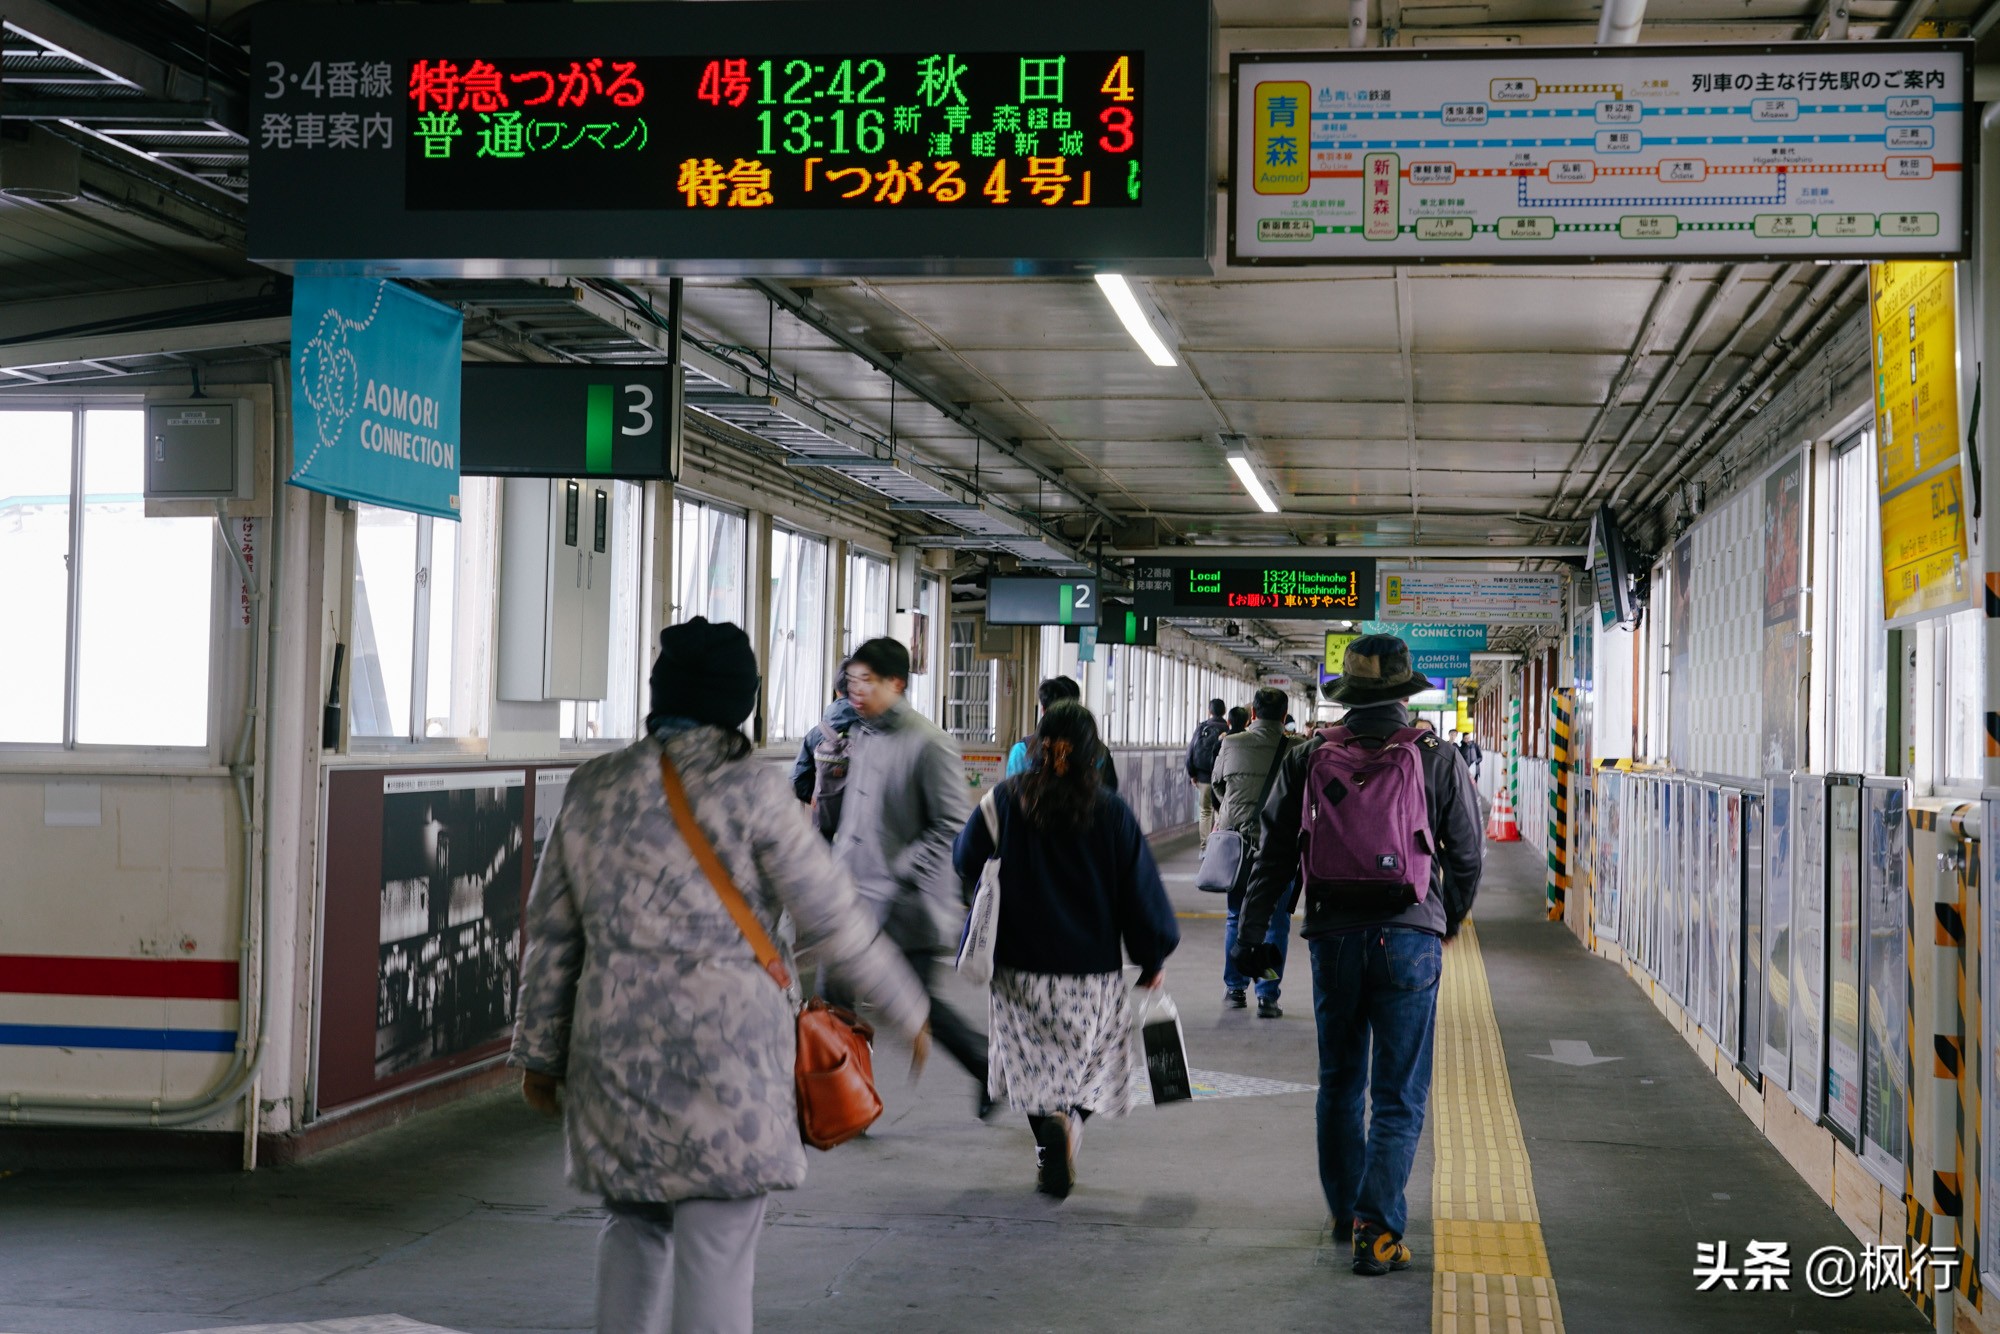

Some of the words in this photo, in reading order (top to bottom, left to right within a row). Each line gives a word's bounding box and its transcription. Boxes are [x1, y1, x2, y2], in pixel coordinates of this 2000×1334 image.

[409, 58, 644, 112] 特急つがる
[698, 58, 751, 107] 4号
[757, 59, 886, 104] 12:42
[1101, 56, 1134, 101] 4
[1692, 69, 1945, 92] 列車の主な行先駅のご案内
[1889, 108, 1930, 116] Hachinohe
[261, 112, 392, 149] 発車案内
[757, 109, 885, 154] 13:16
[1100, 106, 1134, 153] 3
[1267, 96, 1298, 167] 青森
[1900, 160, 1919, 168] 秋田
[1900, 169, 1919, 177] Akita
[1261, 172, 1303, 183] Aomori
[1373, 159, 1390, 215] 新青森
[363, 378, 439, 431] AOMORI
[621, 384, 655, 436] 3
[360, 418, 455, 470] CONNECTION
[1136, 581, 1172, 591] 発車案内
[1190, 569, 1221, 581] Local
[1263, 570, 1296, 582] 13:24
[1298, 571, 1347, 583] Hachinohe
[1350, 571, 1356, 583] 1
[1075, 584, 1091, 608] 2
[1190, 581, 1221, 593] Local
[1263, 582, 1295, 594] 14:37
[1298, 583, 1347, 595] Hachinohe
[1350, 584, 1356, 595] 1
[1411, 628, 1483, 638] CONNECTION
[1418, 653, 1460, 661] AOMORI
